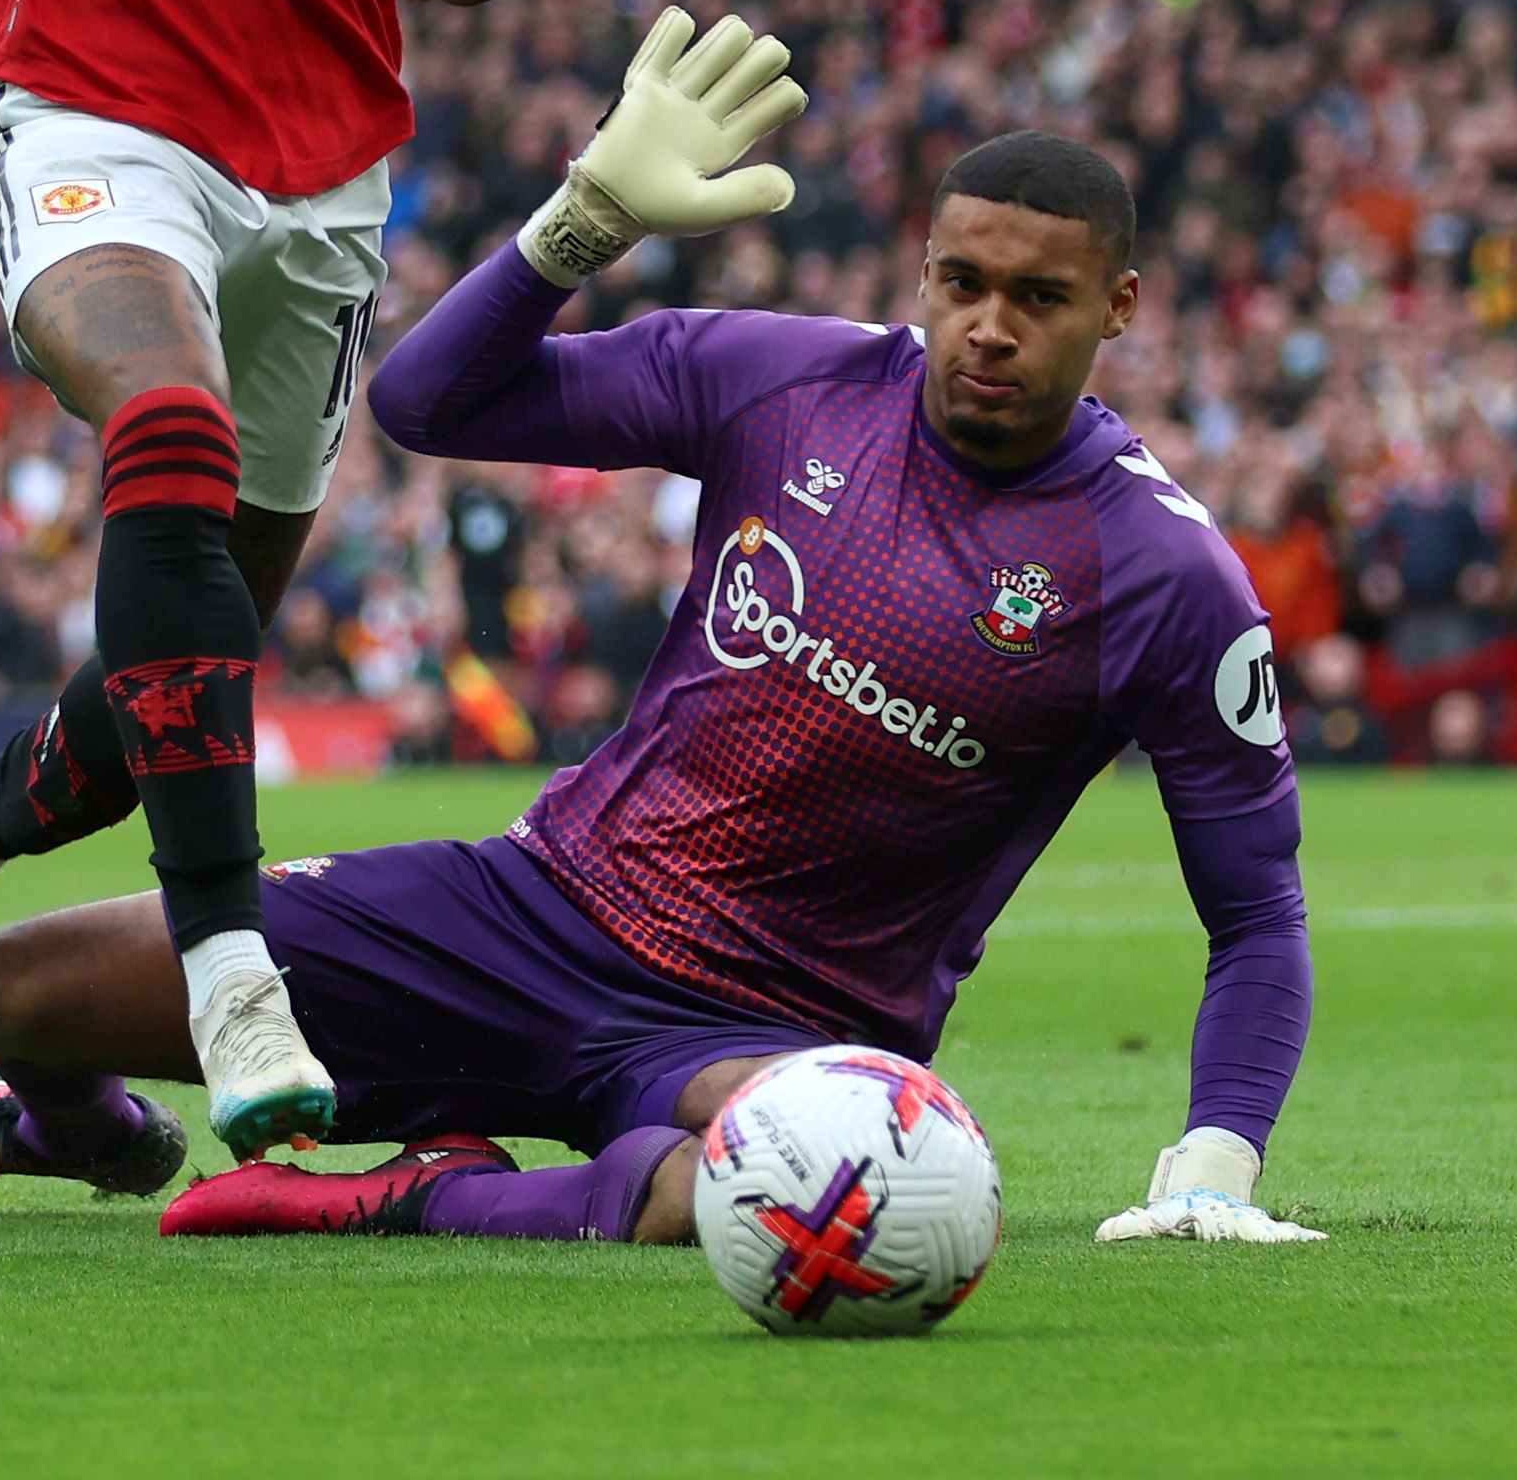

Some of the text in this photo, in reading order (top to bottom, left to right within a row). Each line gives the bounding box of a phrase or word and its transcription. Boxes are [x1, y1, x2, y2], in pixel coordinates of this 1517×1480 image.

[782, 479, 833, 517] hummel
[973, 616, 1035, 652] SOUTHAMPTON FC
[726, 561, 986, 769] Sportsbet.io
[1236, 650, 1276, 726] JD
[750, 1107, 780, 1145] FLIGHT
[778, 1144, 812, 1183] NIKE
